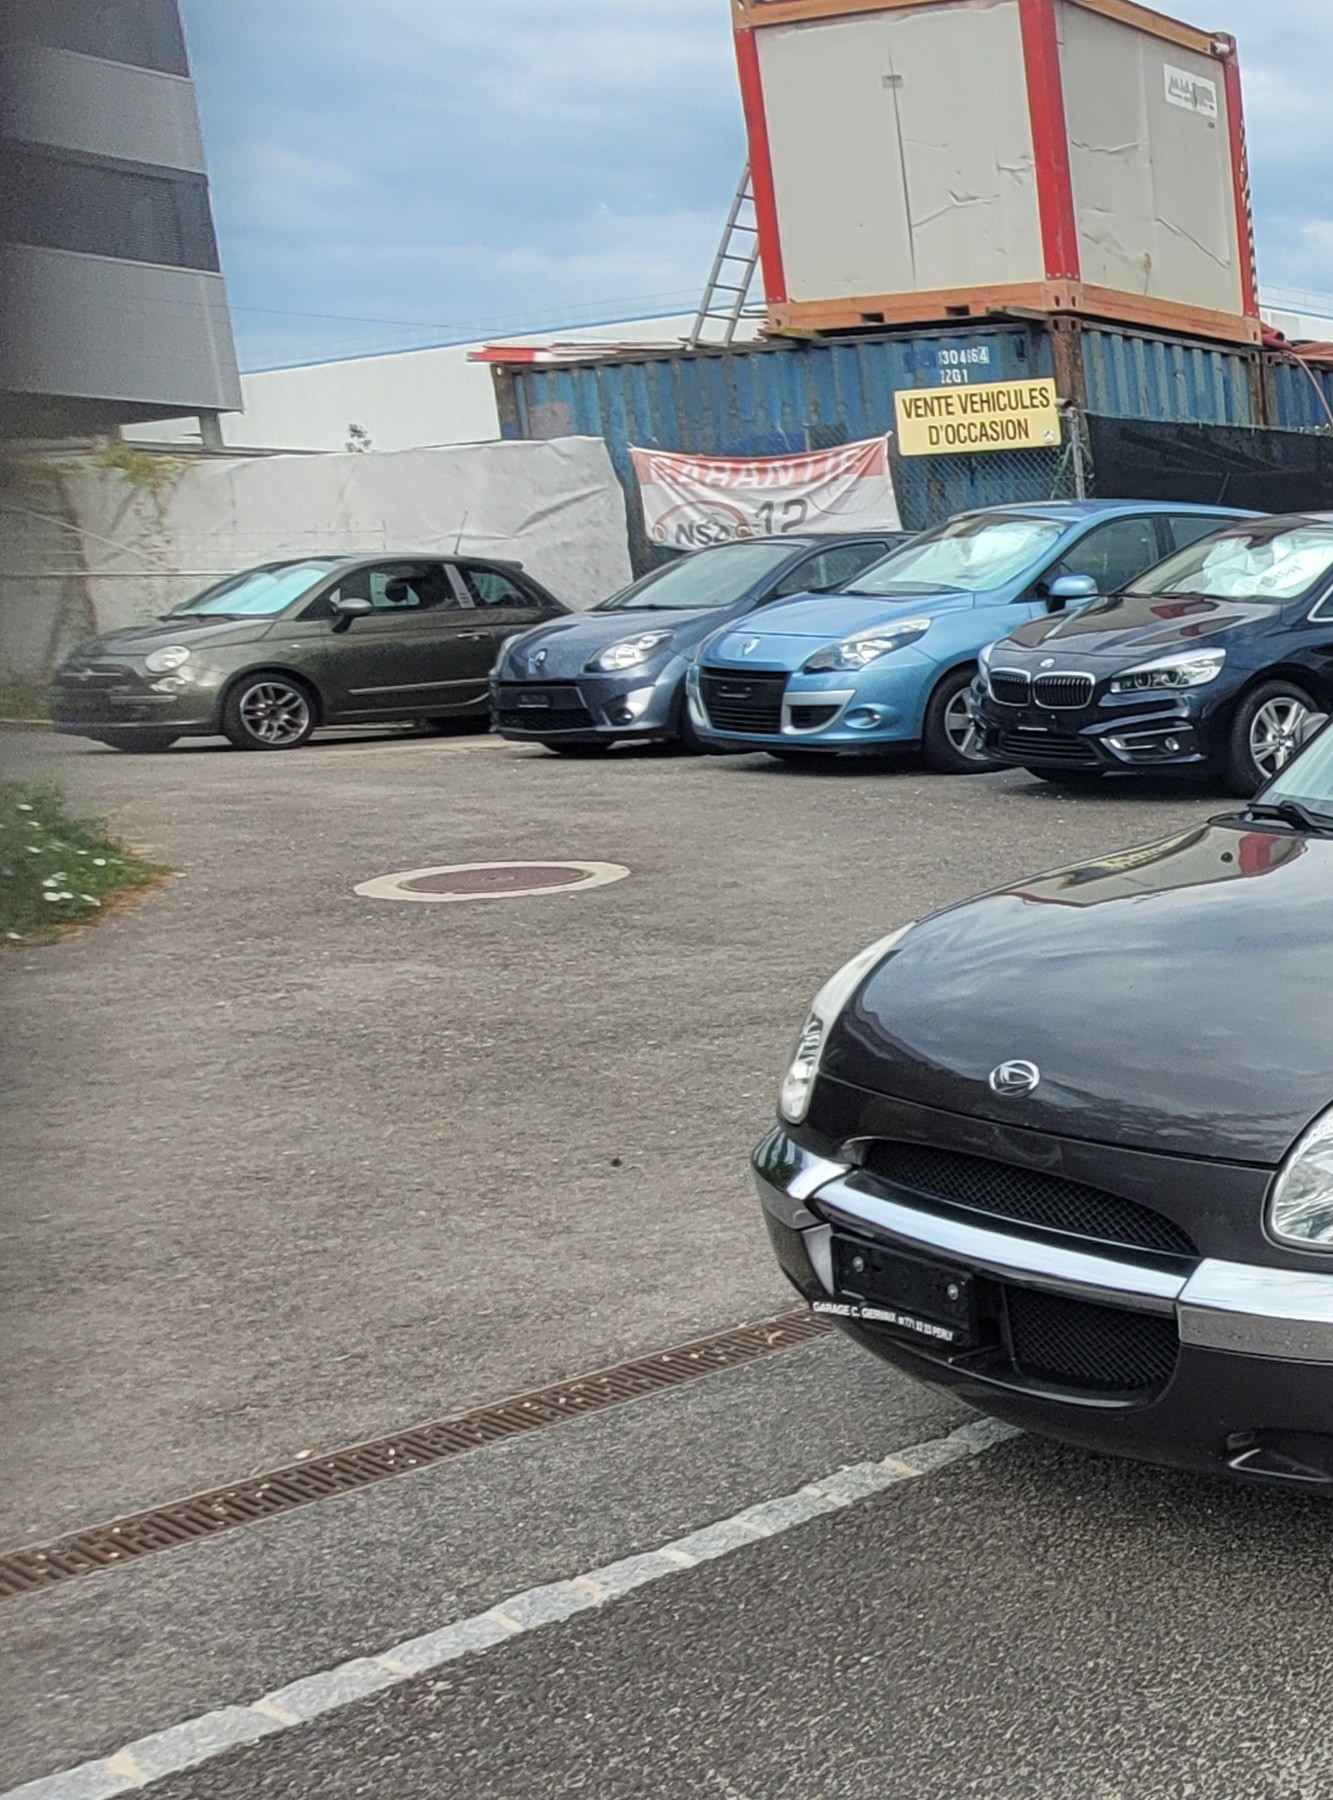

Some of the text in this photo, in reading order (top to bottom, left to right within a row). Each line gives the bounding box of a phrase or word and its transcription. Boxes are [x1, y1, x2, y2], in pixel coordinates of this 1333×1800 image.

[902, 386, 1050, 419] VENTE VEHICULES
[928, 418, 1029, 446] D'OCCASION
[813, 1302, 850, 1315] GARAGE
